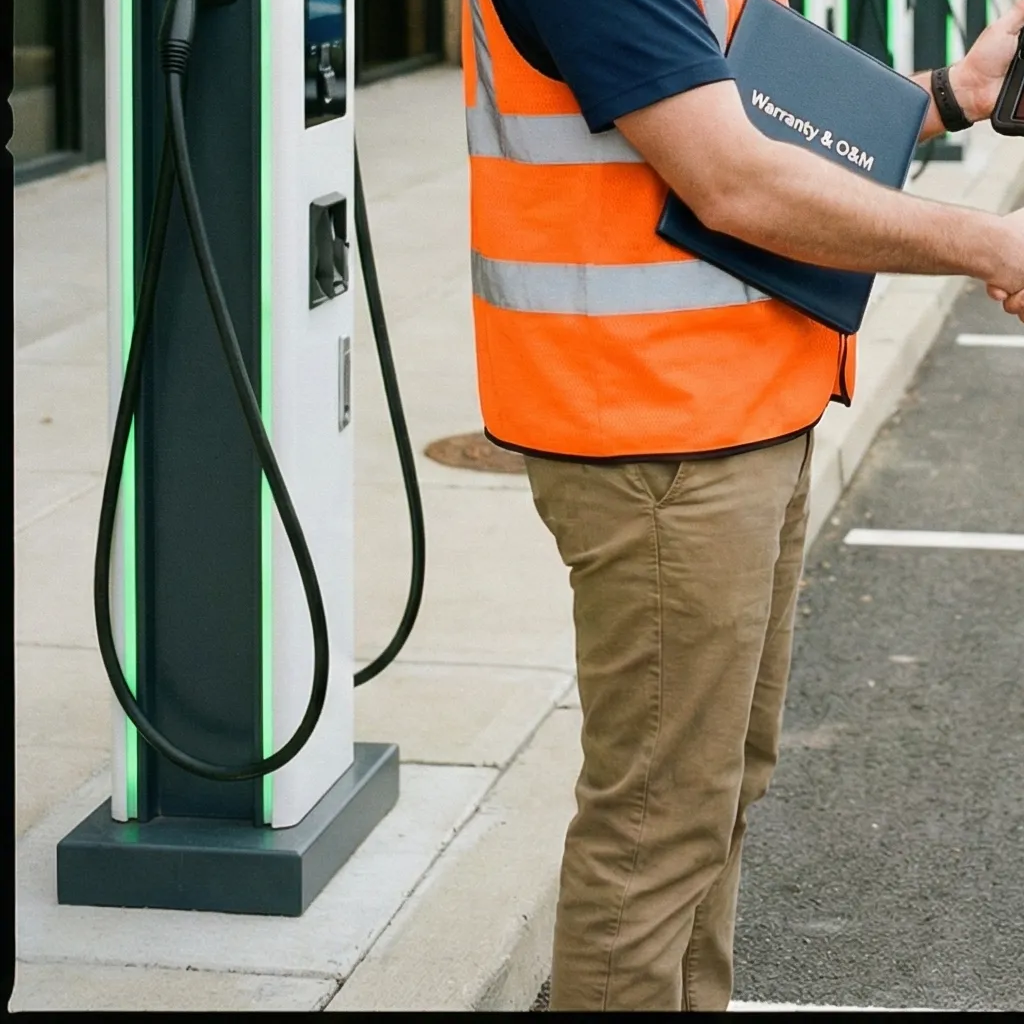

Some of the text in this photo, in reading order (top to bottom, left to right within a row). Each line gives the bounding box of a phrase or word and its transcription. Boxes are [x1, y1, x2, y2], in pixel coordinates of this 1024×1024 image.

[751, 89, 875, 172] Warranty & O&M
